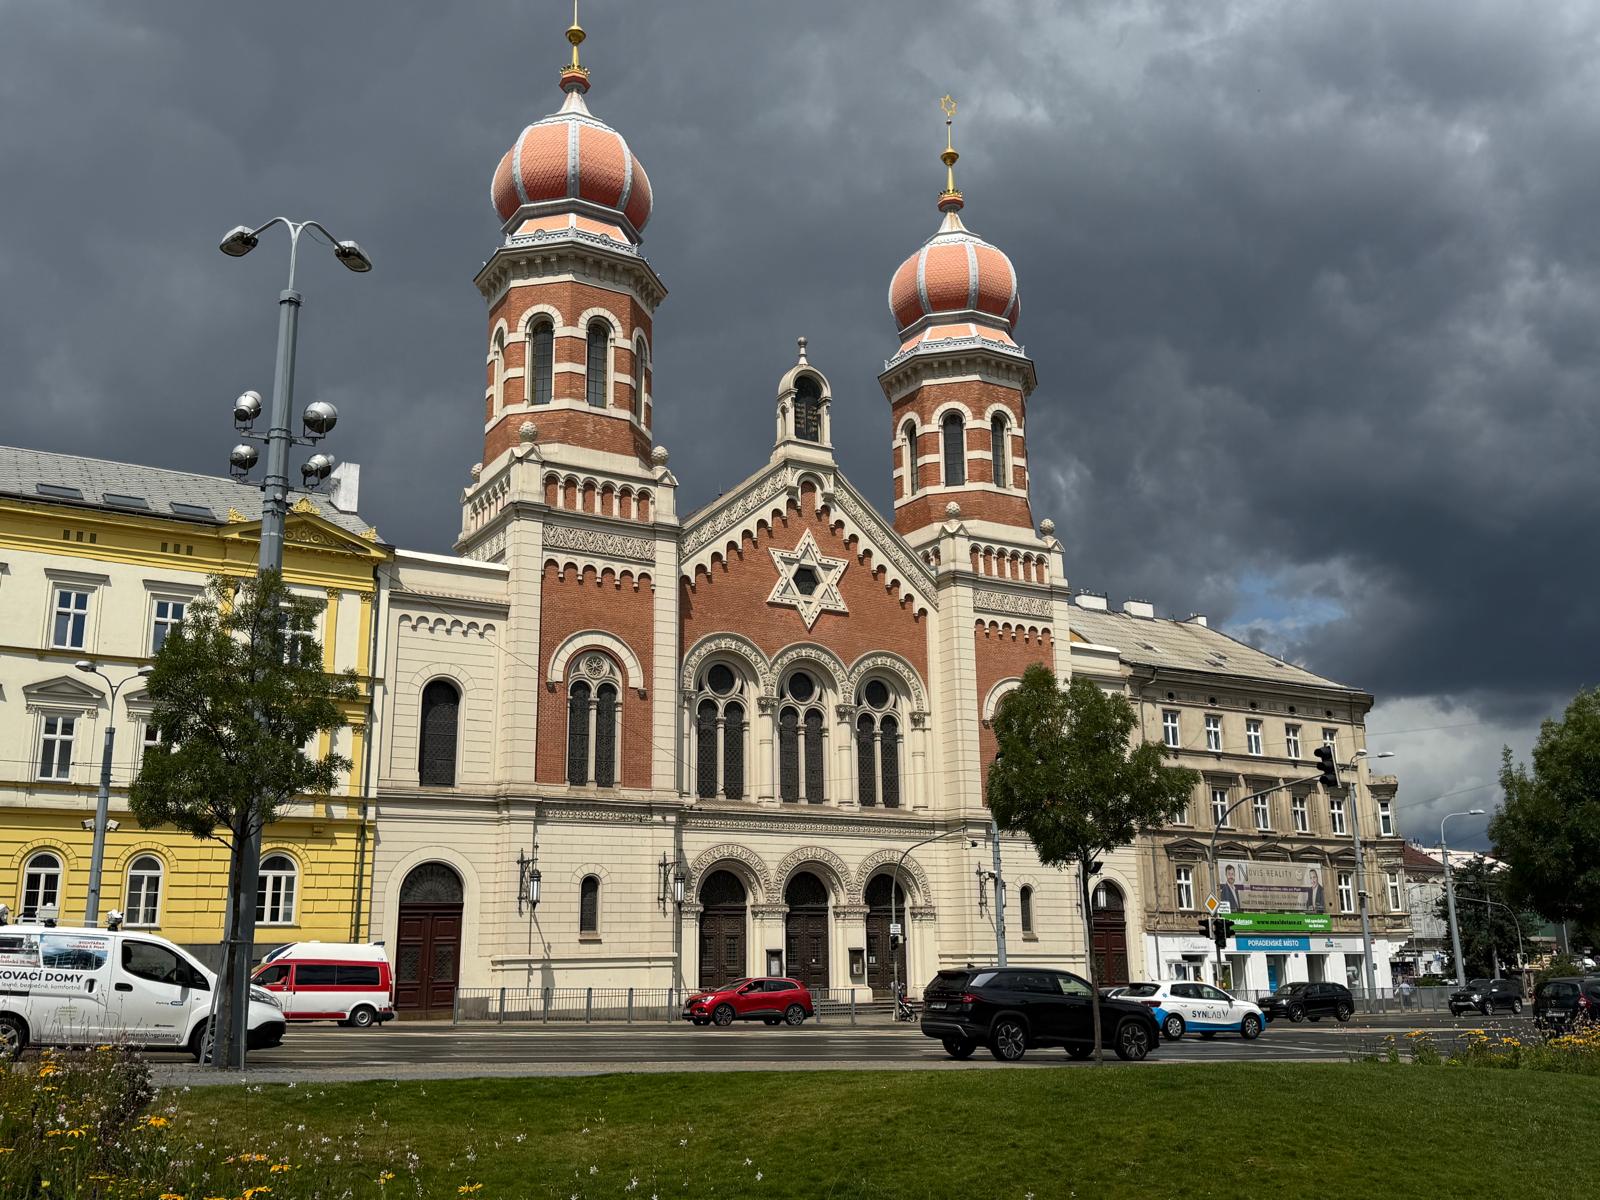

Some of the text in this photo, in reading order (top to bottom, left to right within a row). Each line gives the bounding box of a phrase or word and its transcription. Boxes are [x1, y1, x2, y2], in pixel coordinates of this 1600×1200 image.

[1283, 938, 1299, 947] MÍSTO
[45, 973, 83, 983] DOMY
[1192, 1010, 1221, 1019] SYNLAB
